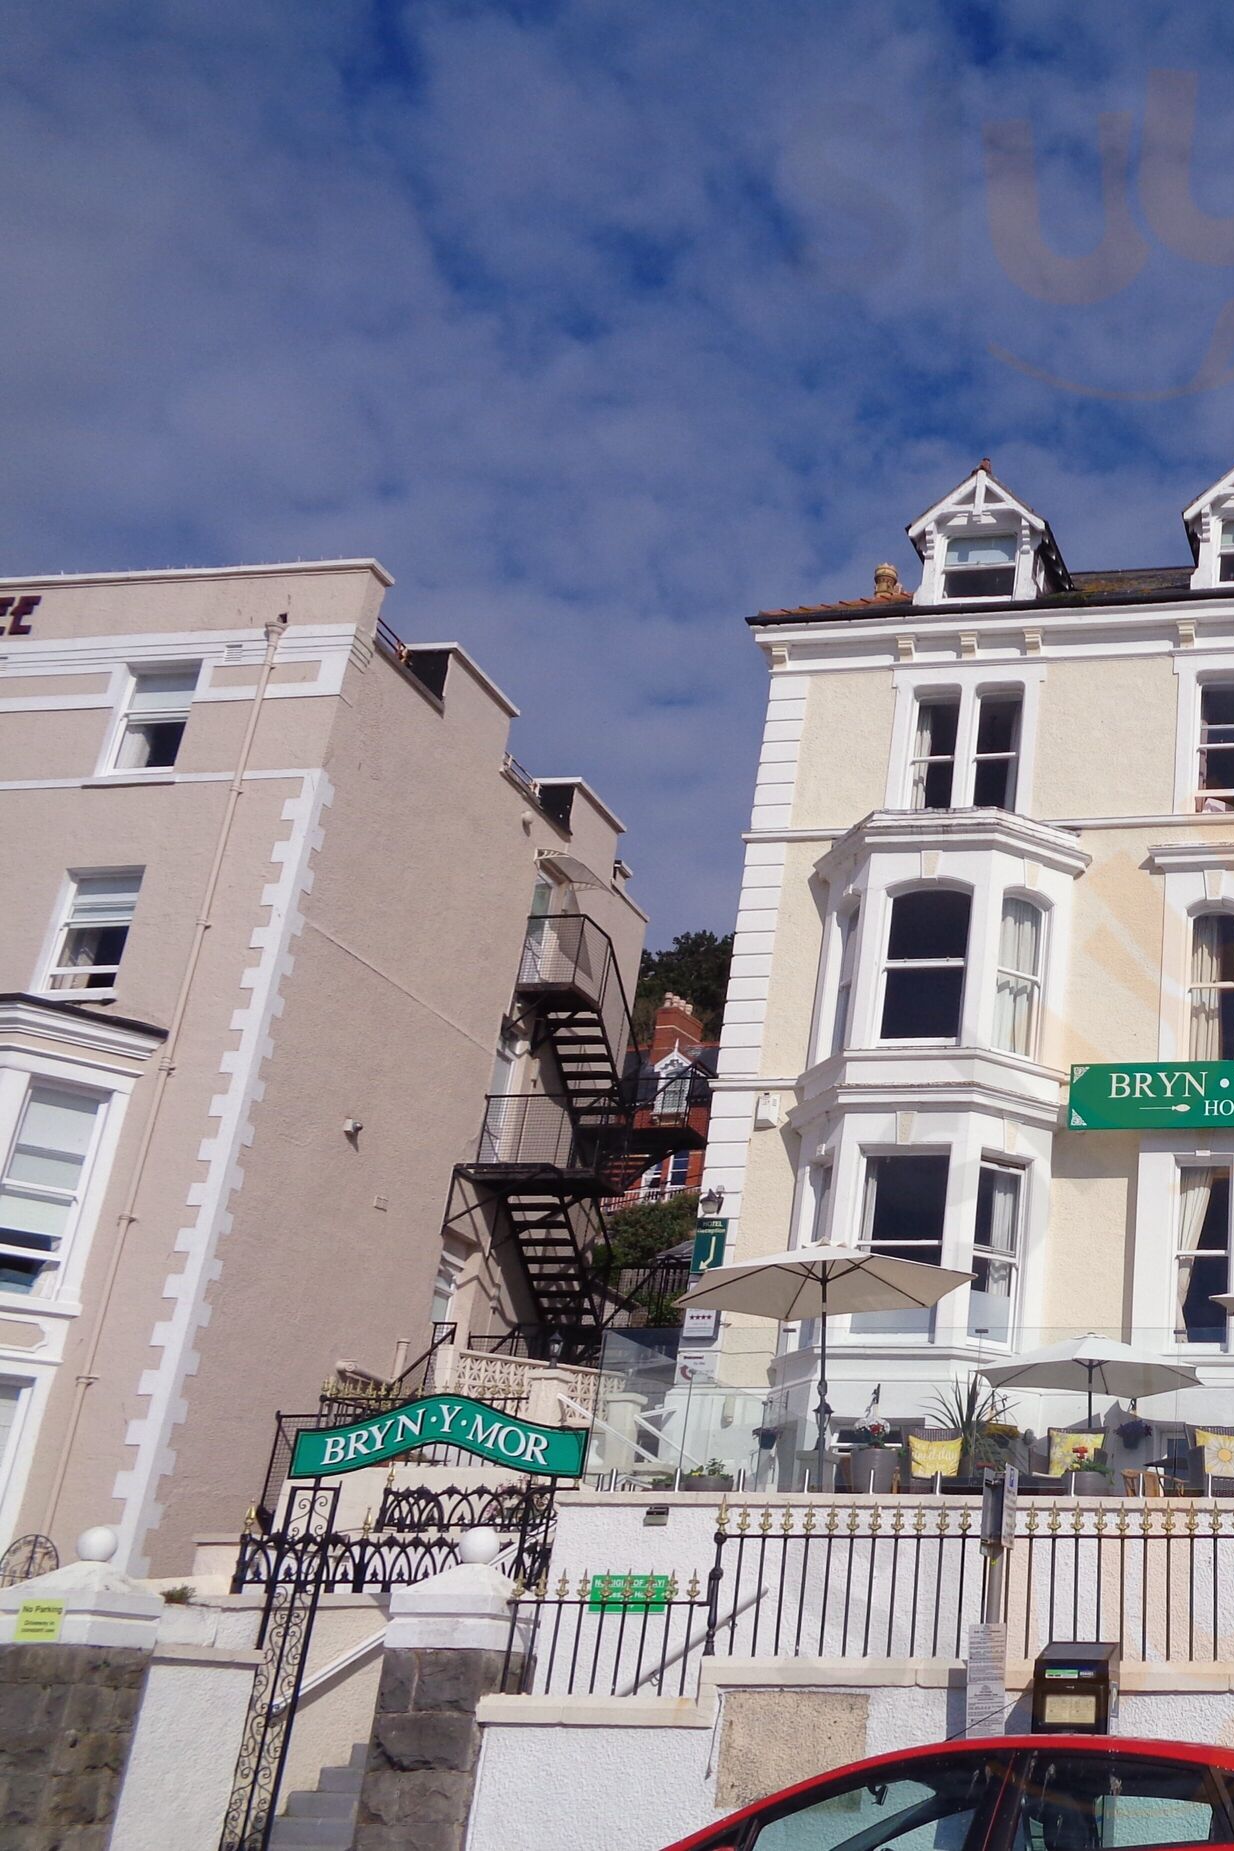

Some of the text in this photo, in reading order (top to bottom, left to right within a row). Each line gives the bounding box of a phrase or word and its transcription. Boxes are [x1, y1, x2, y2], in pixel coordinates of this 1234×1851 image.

[1107, 1071, 1209, 1099] BRYN
[320, 1404, 549, 1465] BRYN Y MOR
[23, 1605, 63, 1615] No Parking
